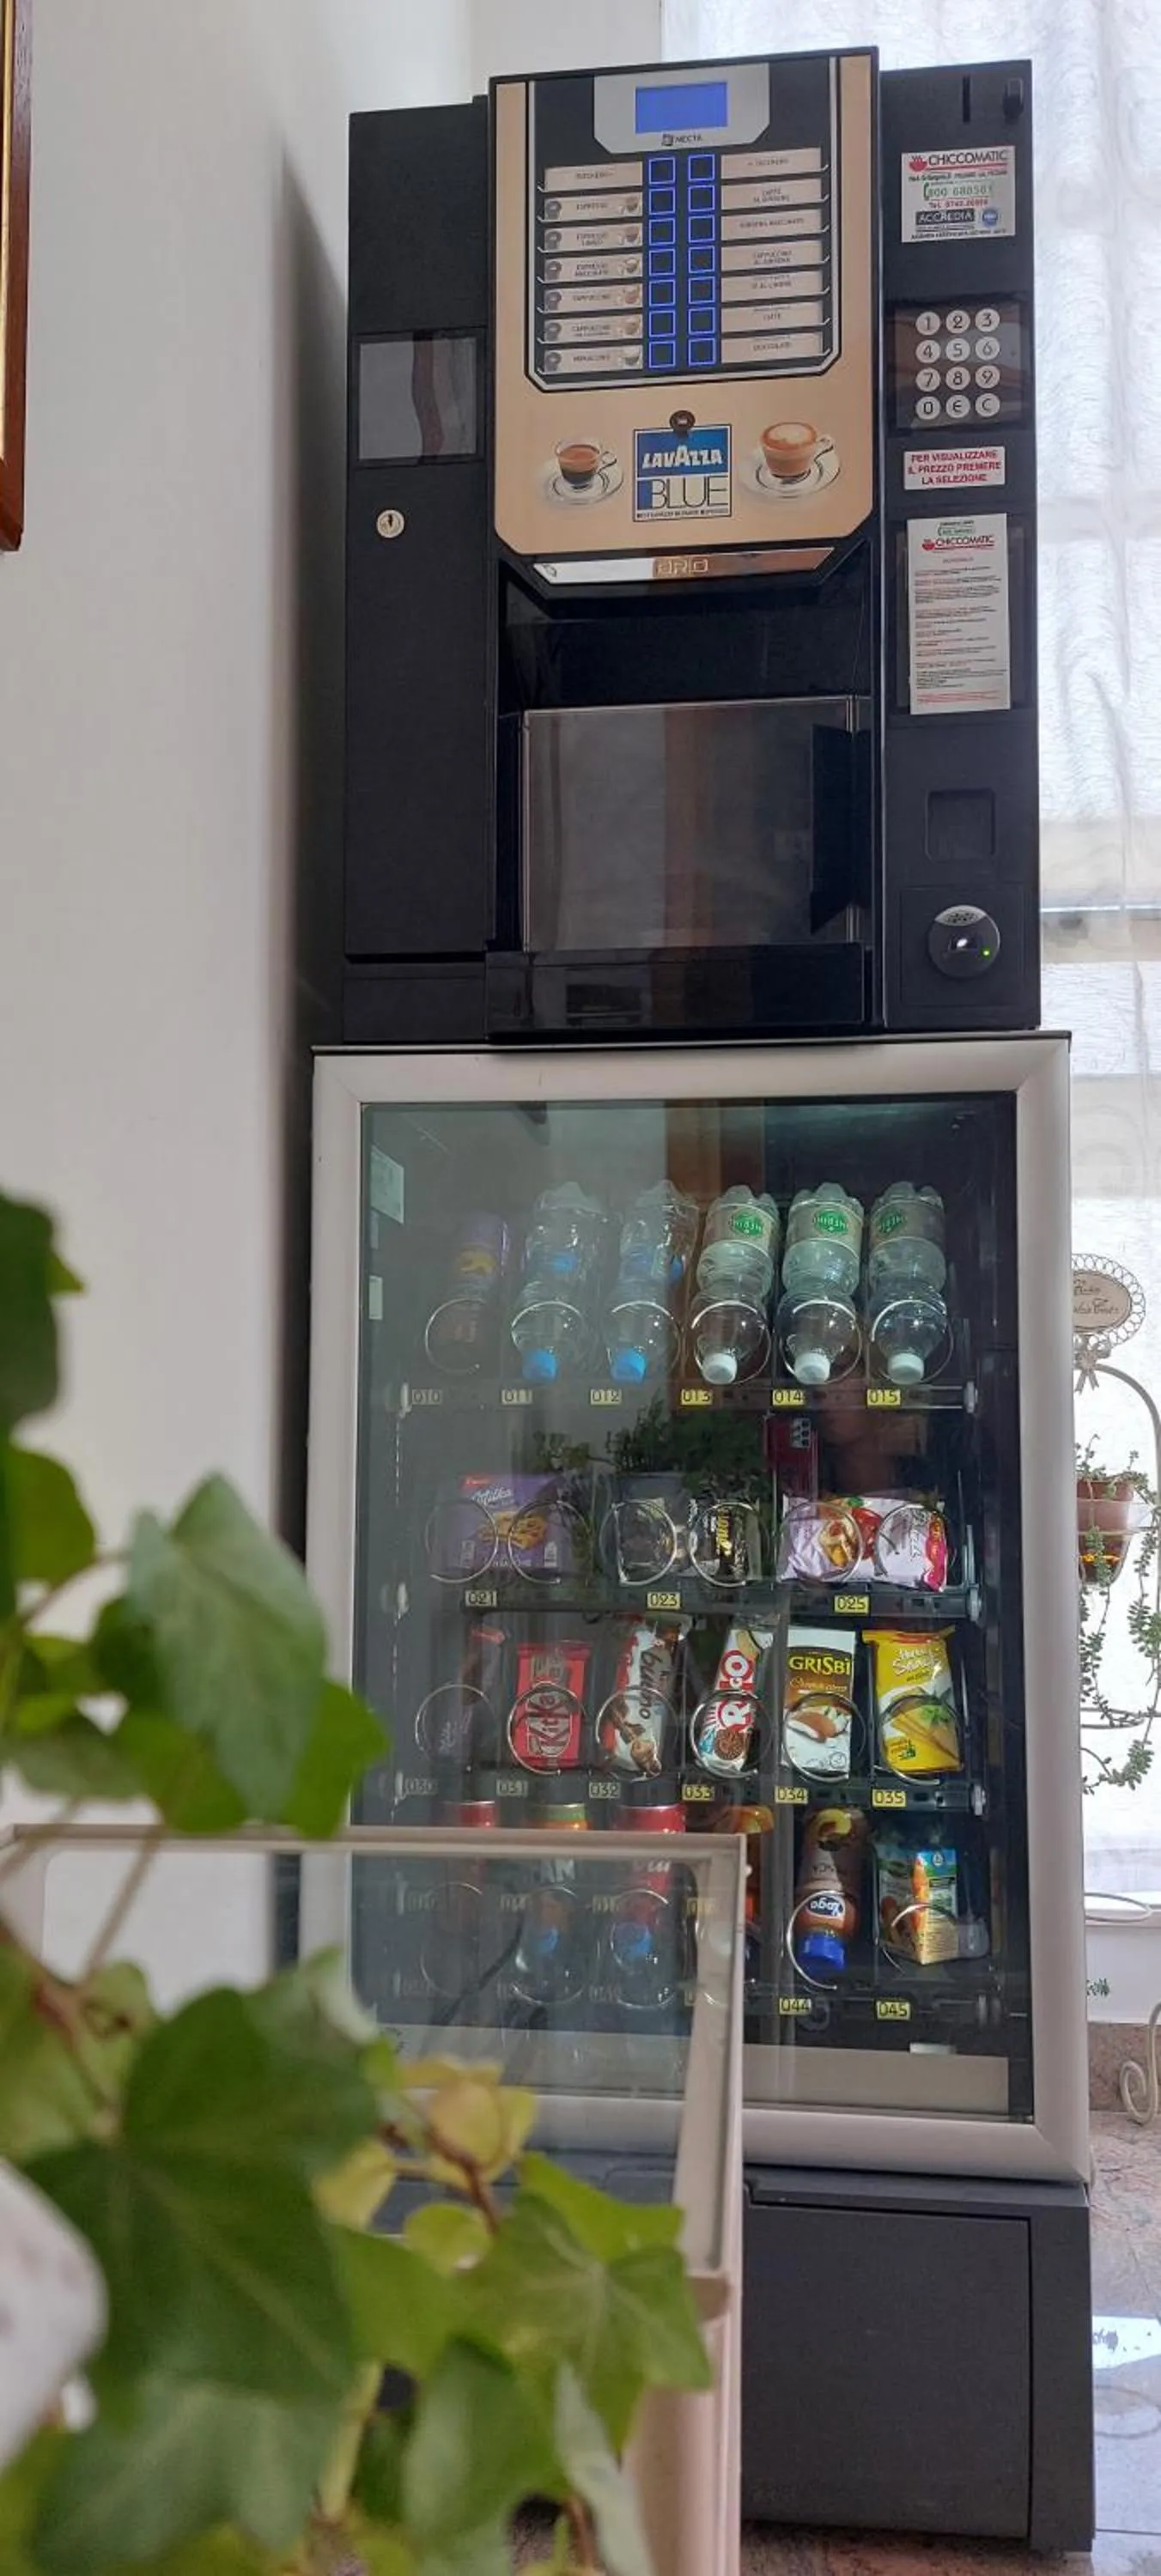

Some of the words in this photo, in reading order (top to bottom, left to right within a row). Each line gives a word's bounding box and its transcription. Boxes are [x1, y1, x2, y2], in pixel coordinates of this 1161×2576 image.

[928, 150, 1009, 166] CHICCOMATIC
[952, 315, 963, 328] 2
[982, 313, 992, 326] 3
[923, 344, 933, 358] 4
[952, 343, 962, 357] 5
[982, 342, 992, 355] 6
[923, 372, 933, 387] 7
[952, 371, 962, 385] 8
[982, 370, 993, 383] 9
[923, 401, 933, 414] 0
[982, 398, 992, 411] C
[641, 445, 723, 469] LAVAZZA
[911, 453, 929, 462] PER
[932, 449, 999, 461] VISUALIZZARE
[918, 464, 954, 473] PREZZO
[957, 461, 1001, 471] PREMERE
[921, 476, 933, 485] LA
[936, 473, 987, 484] SELEZIONE
[651, 476, 729, 510] BLUE
[683, 1390, 711, 1403] 013
[775, 1390, 802, 1404] 014
[869, 1390, 898, 1404] 015
[468, 1592, 495, 1606] 021
[651, 1593, 678, 1607] 023
[837, 1597, 866, 1611] 025
[591, 1784, 617, 1796] 032
[684, 1786, 713, 1799] 033
[778, 1789, 805, 1801] 034
[875, 1792, 904, 1804] 035
[781, 1999, 809, 2012] 044
[878, 2002, 908, 2016] 045
